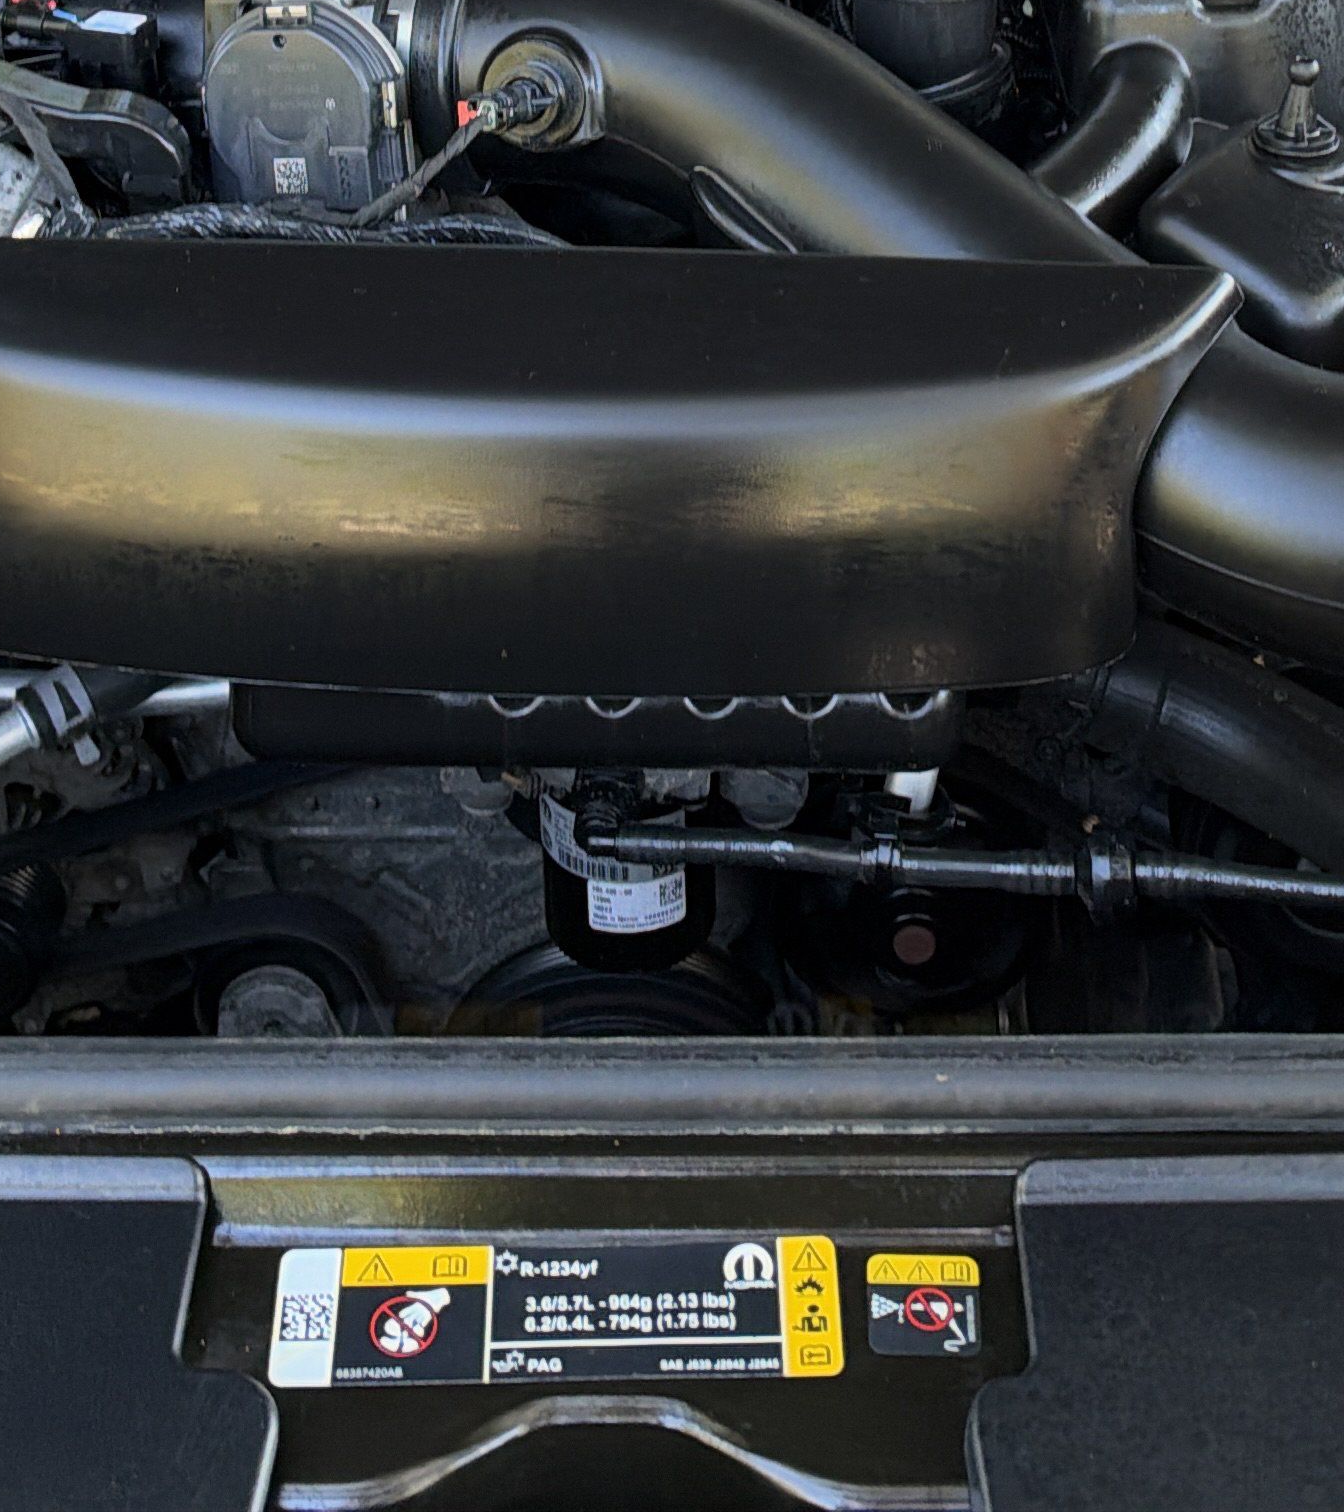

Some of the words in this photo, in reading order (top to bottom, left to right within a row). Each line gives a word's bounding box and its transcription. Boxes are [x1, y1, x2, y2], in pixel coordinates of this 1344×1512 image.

[520, 1259, 599, 1280] R-1234yf
[657, 1292, 698, 1312] (2.13
[702, 1291, 736, 1312] lbs)
[657, 1312, 699, 1332] (1.75
[703, 1311, 737, 1331] lbs)
[527, 1357, 563, 1373] PAG
